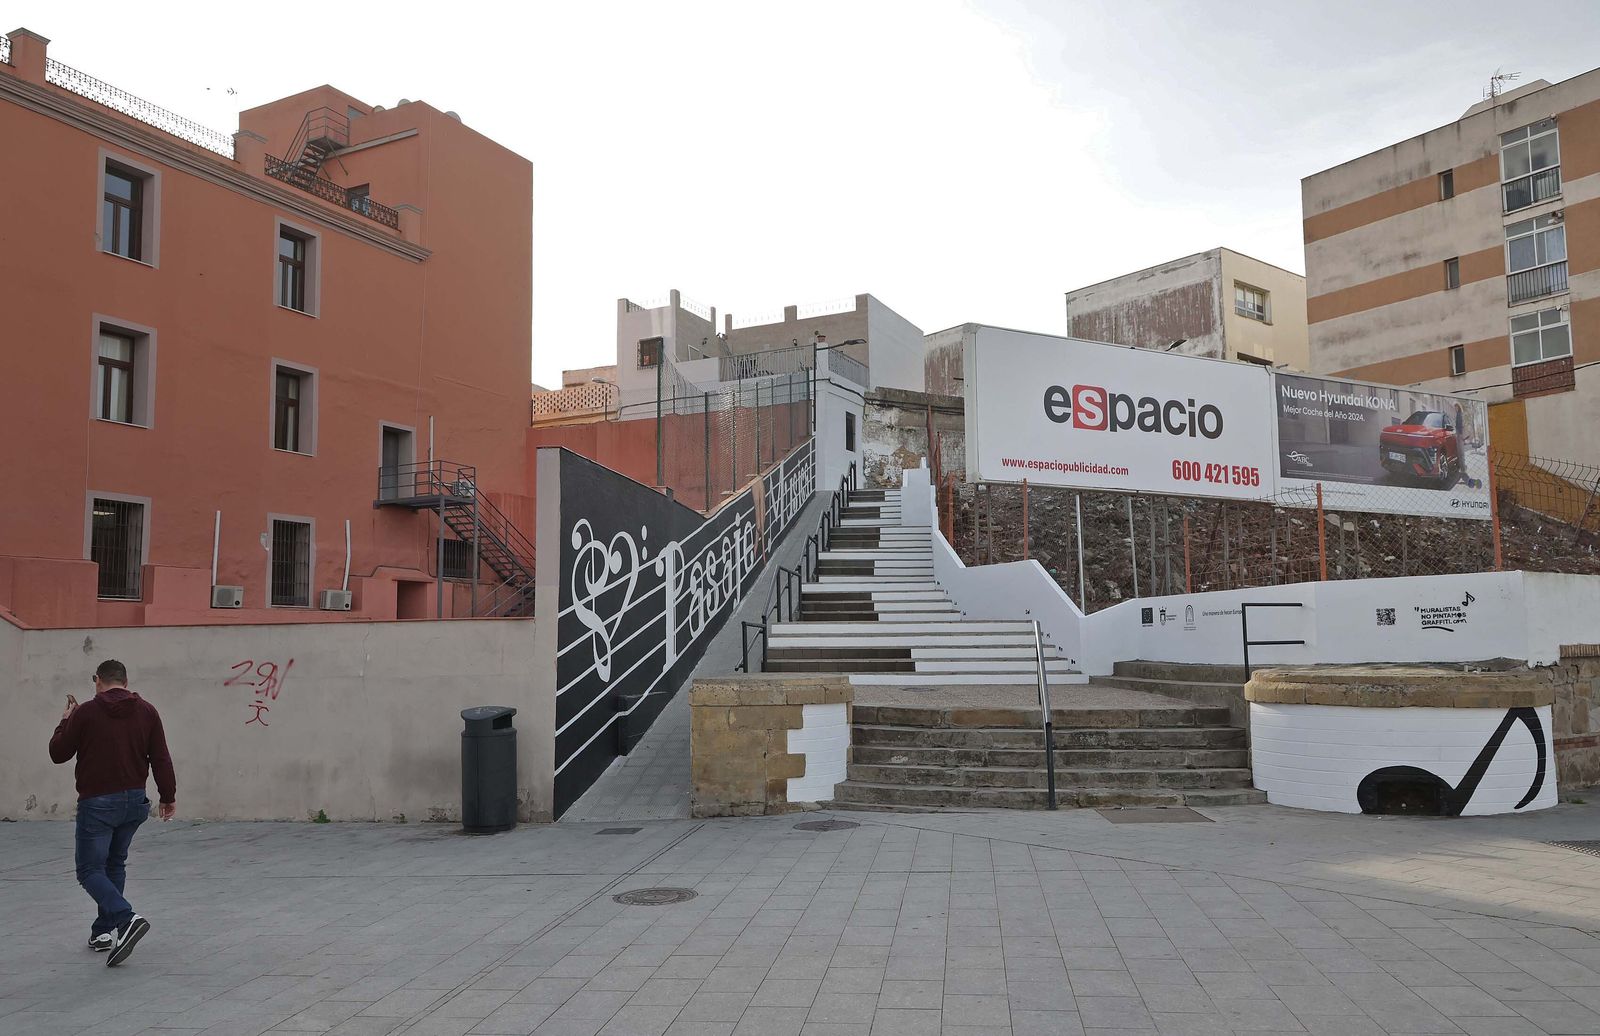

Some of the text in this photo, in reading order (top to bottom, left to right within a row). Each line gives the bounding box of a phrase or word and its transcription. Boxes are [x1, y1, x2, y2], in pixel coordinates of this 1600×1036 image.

[1281, 385, 1396, 411] Nuevo Hyundai KONA
[1044, 384, 1224, 440] espacio
[1283, 404, 1301, 415] Mejor
[1302, 406, 1323, 417] Coche
[1324, 410, 1334, 418] del
[1334, 411, 1348, 420] Año
[1002, 458, 1129, 476] www.espaciopublicidad.com
[1172, 460, 1201, 482] 600
[1204, 463, 1229, 485] 421
[1232, 465, 1260, 487] 595
